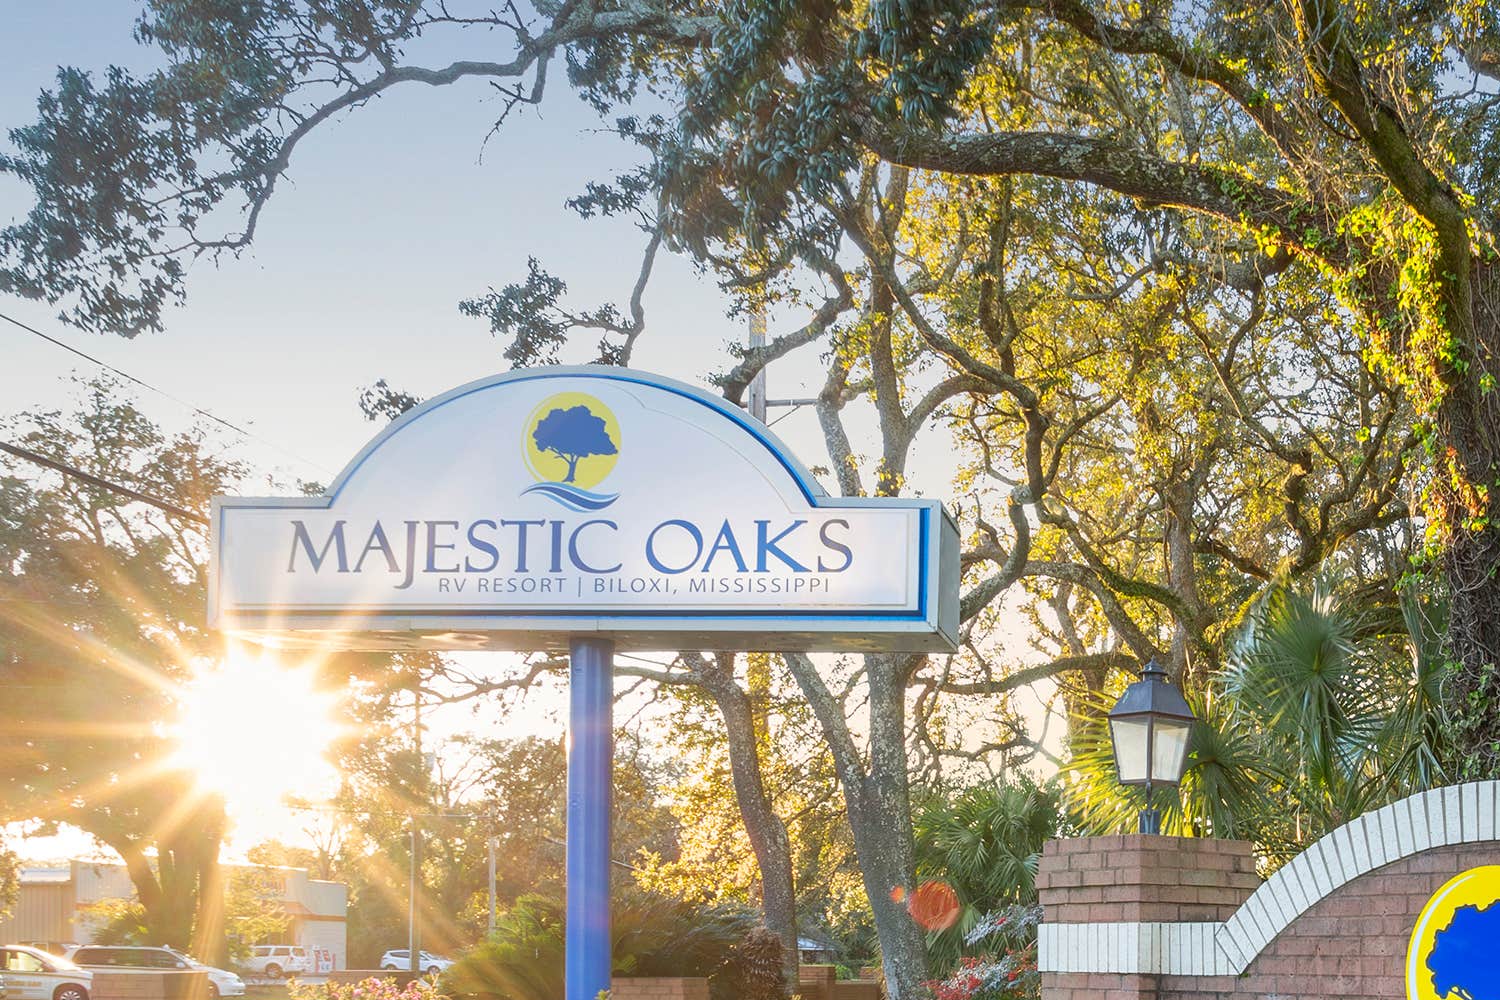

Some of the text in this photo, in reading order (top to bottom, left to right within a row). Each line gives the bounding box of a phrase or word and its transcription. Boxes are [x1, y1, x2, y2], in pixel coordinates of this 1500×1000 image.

[287, 518, 853, 590] MAJESTIC OAKS
[438, 577, 830, 595] RV RESORT BILOXI, MISSISSIPPI
